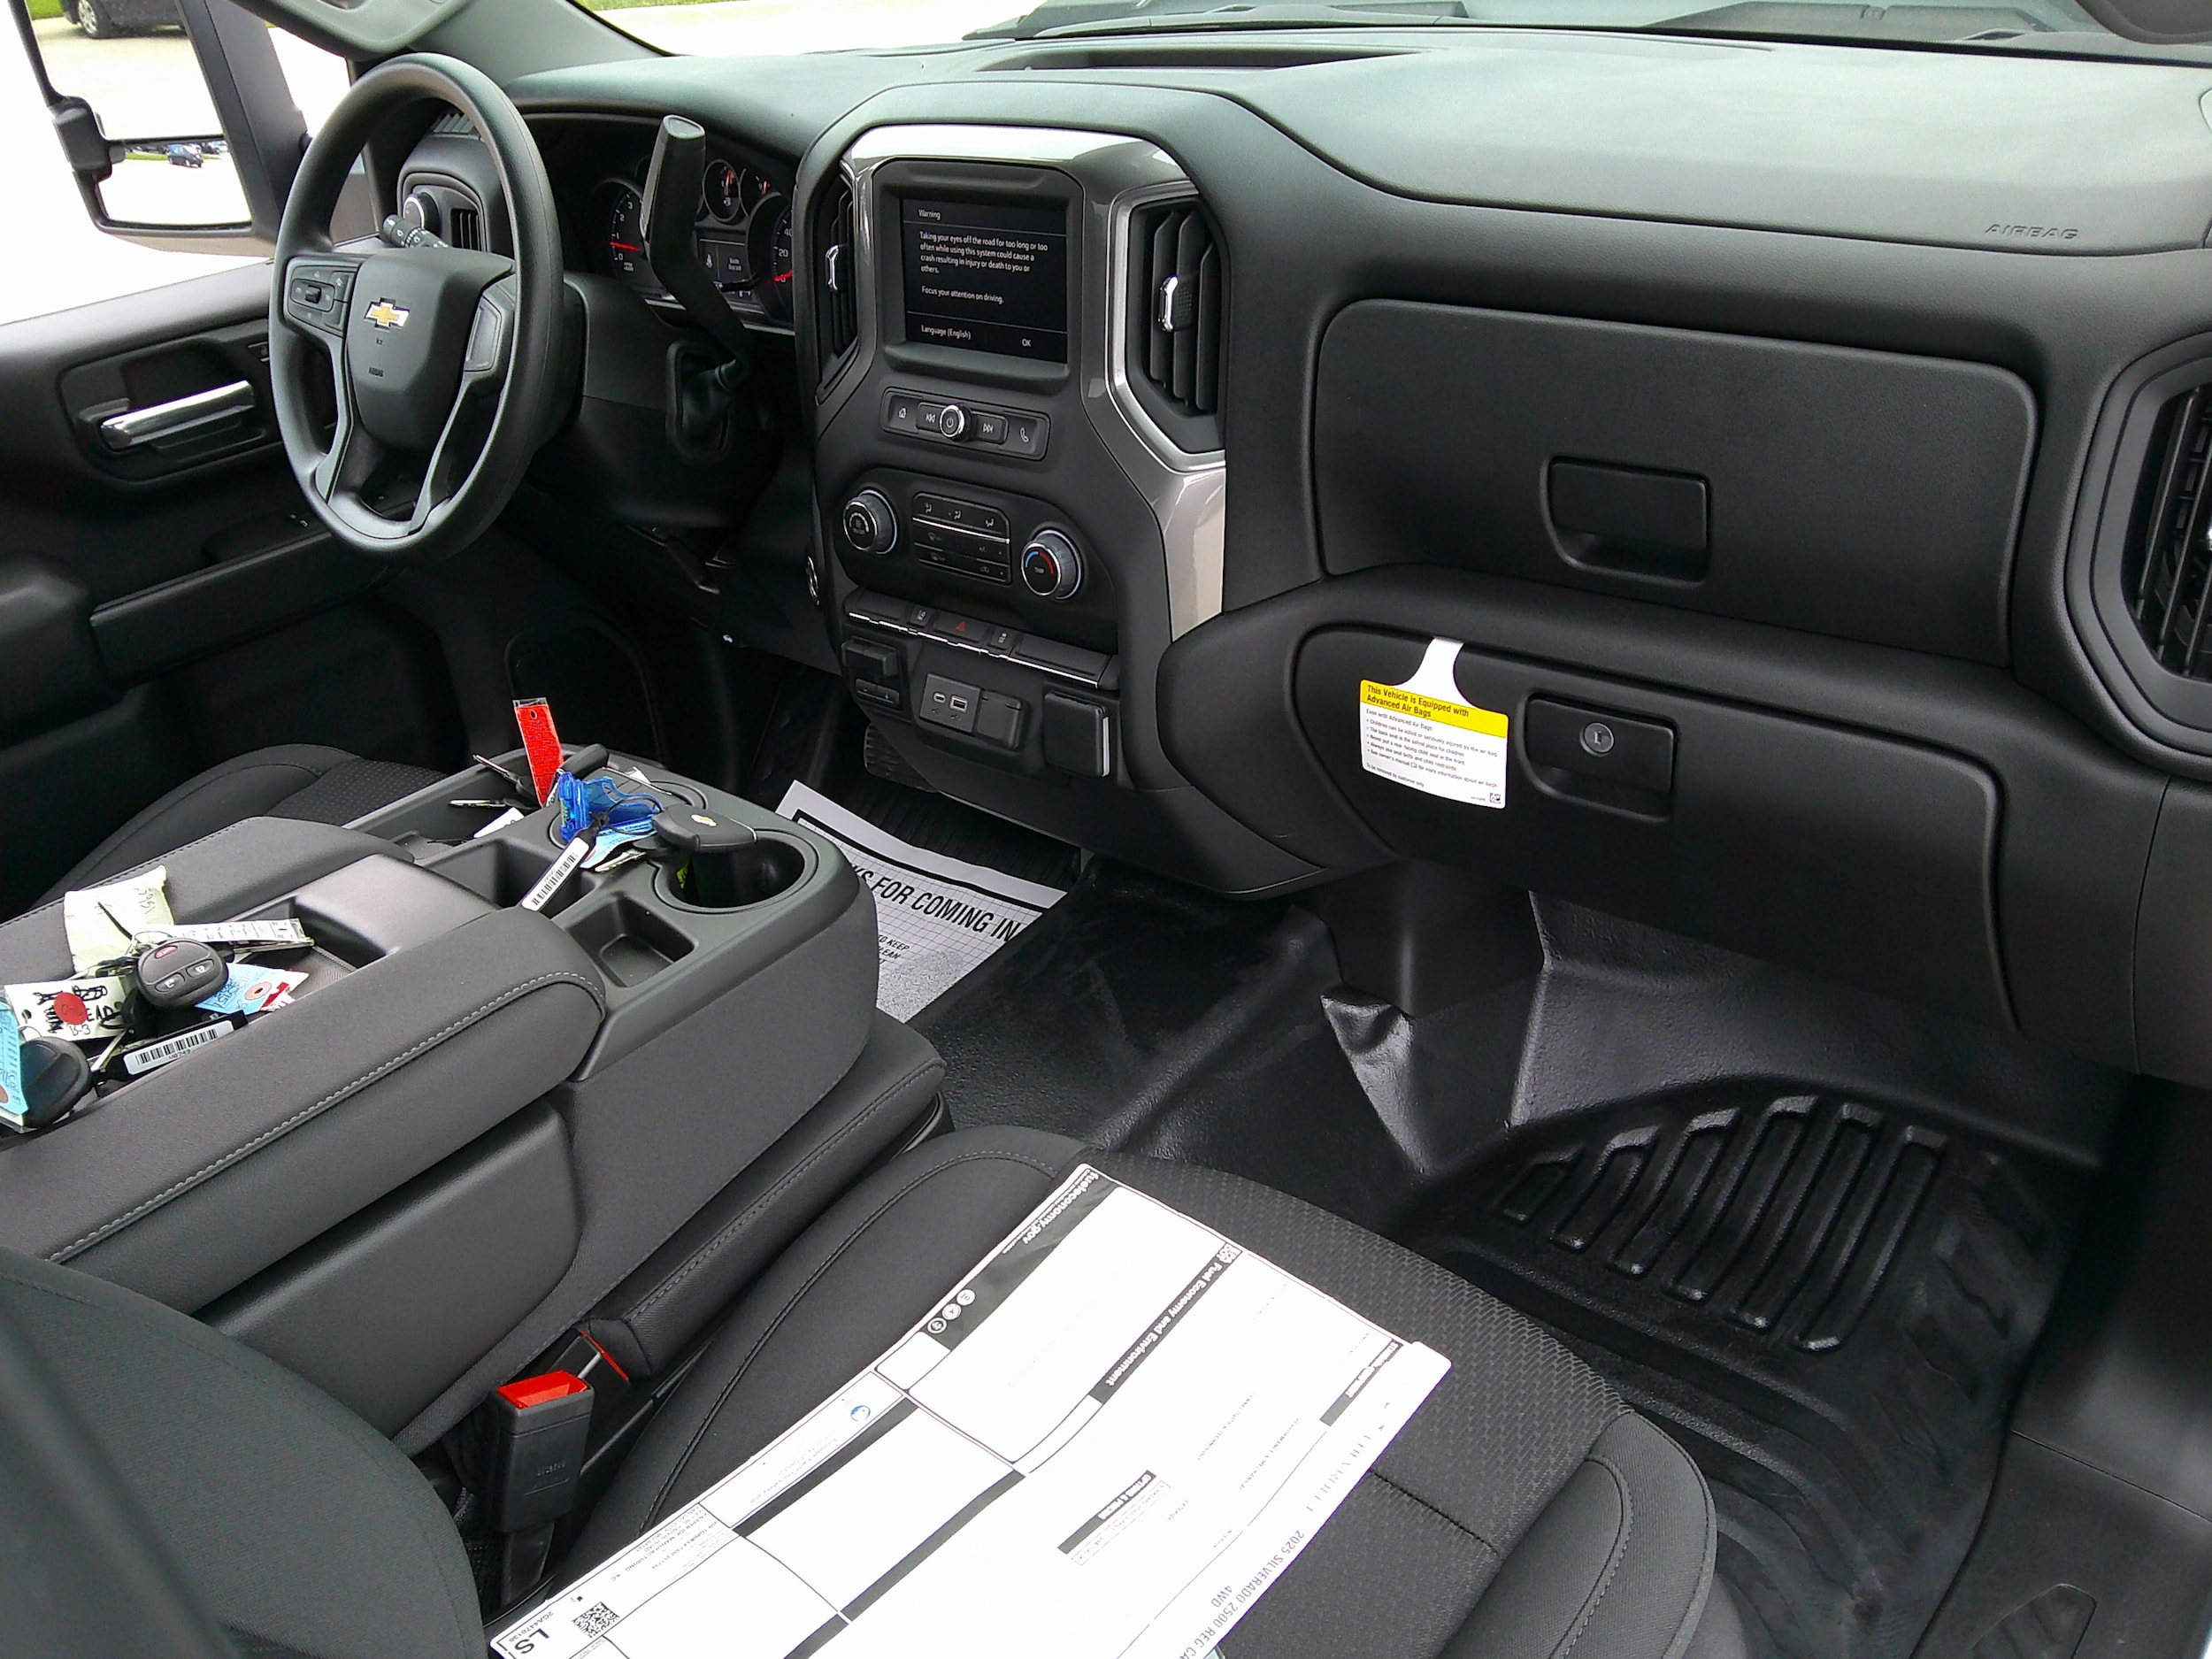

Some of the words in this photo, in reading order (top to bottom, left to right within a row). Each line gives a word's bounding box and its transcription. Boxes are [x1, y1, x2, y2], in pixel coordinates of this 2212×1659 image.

[918, 210, 941, 220] Warning
[919, 231, 937, 242] Taking
[1017, 240, 1029, 251] long
[1985, 224, 2078, 239] AIRBAG
[778, 248, 788, 257] 20
[950, 247, 964, 256] using
[977, 249, 995, 257] system
[921, 265, 940, 273] others.
[936, 257, 958, 266] resulting
[965, 257, 980, 269] injury
[921, 286, 938, 295] Focus
[984, 293, 1004, 304] driving.
[921, 325, 946, 336] Language
[948, 328, 972, 340] (English)
[1367, 685, 1381, 695] This
[1383, 688, 1408, 701] Vehicle
[1418, 697, 1451, 712] Equipped
[1453, 708, 1469, 717] with
[1367, 695, 1400, 708] Advanced
[1414, 706, 1432, 718] Bags
[1370, 719, 1387, 729] Children
[1404, 728, 1417, 737] killed
[1424, 734, 1445, 744] seriously
[1389, 715, 1411, 726] Advanced
[1420, 723, 1432, 732] Bags
[870, 877, 915, 905] FOR
[910, 892, 995, 934] COMING
[995, 918, 1021, 942] IN
[878, 945, 901, 959] LEAN
[887, 939, 910, 949] KEEP
[1022, 1171, 1098, 1244] fueleconomy.gov
[1202, 1262, 1222, 1279] Fuel
[1168, 1279, 1206, 1315] Economy
[1152, 1315, 1171, 1333] and
[1104, 1331, 1158, 1386] Environment
[1279, 1529, 1305, 1555] 2025
[1233, 1553, 1283, 1604] SILVERADO
[1210, 1583, 1233, 1608] 4WD
[1211, 1601, 1239, 1628] 2500
[513, 1627, 549, 1655] LS
[1193, 1625, 1216, 1648] REG
